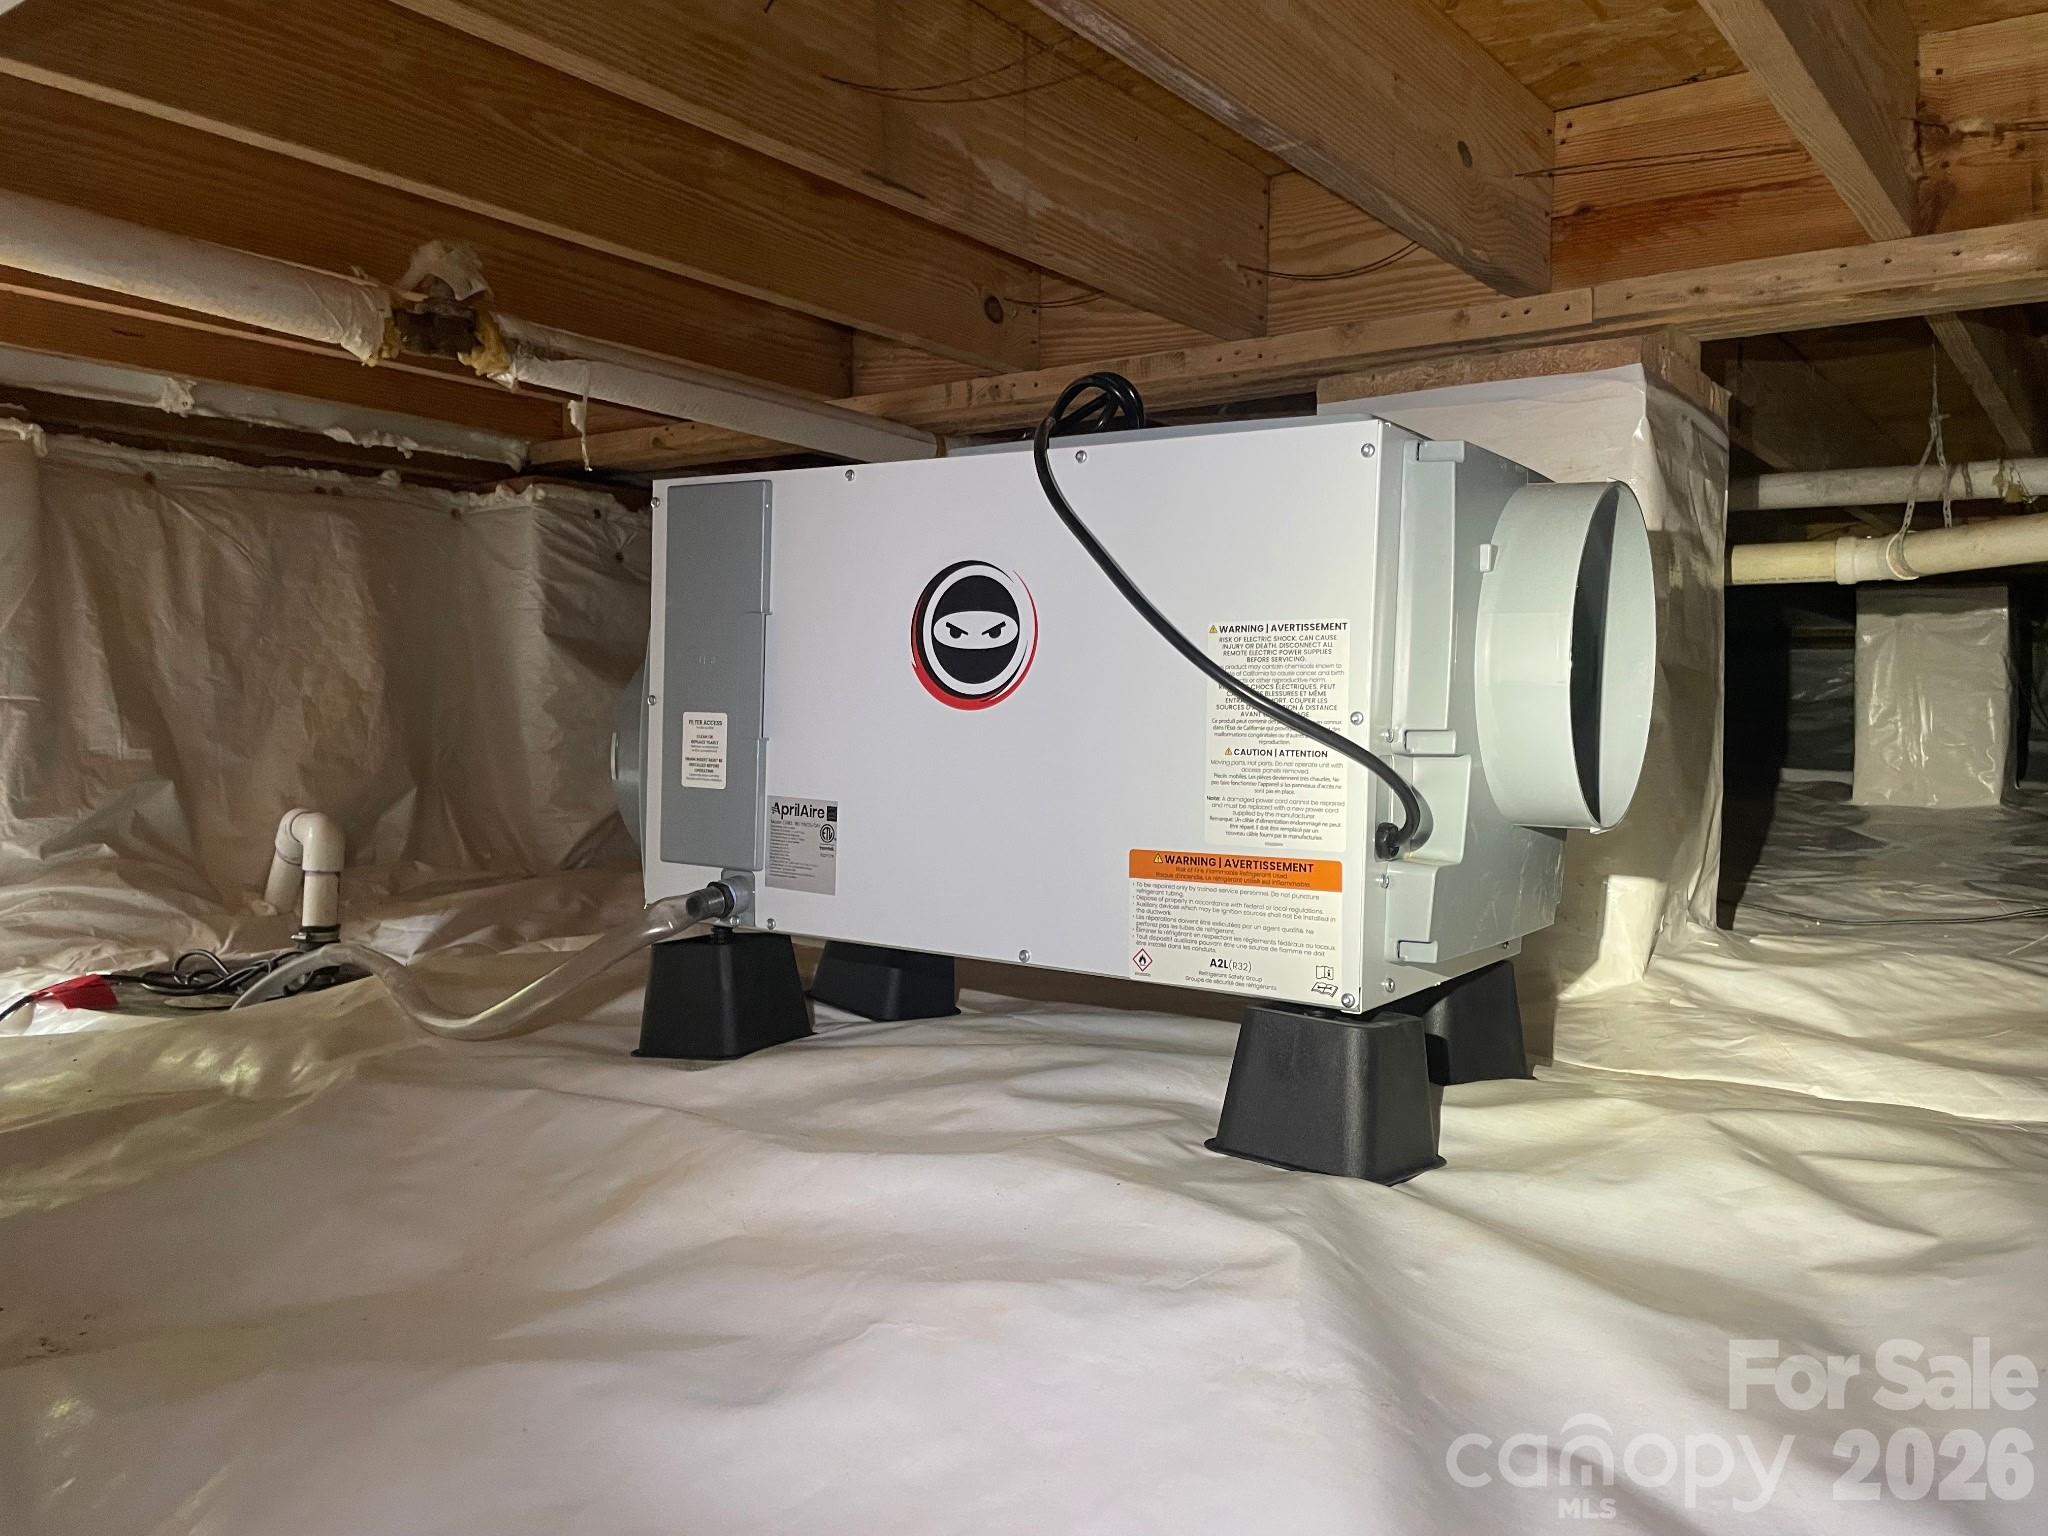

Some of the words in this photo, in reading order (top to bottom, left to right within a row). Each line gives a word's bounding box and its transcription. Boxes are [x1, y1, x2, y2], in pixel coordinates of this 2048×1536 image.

[1219, 624, 1264, 633] WARNING
[1271, 622, 1348, 632] AVERTISSEMENT
[1234, 749, 1272, 757] CAUTION
[1279, 749, 1328, 758] ATTENTION
[772, 802, 825, 820] AprilAire
[1165, 855, 1216, 866] WARNING
[1224, 858, 1314, 872] AVERTISSEMENT
[1210, 958, 1252, 973] A2L(R32)
